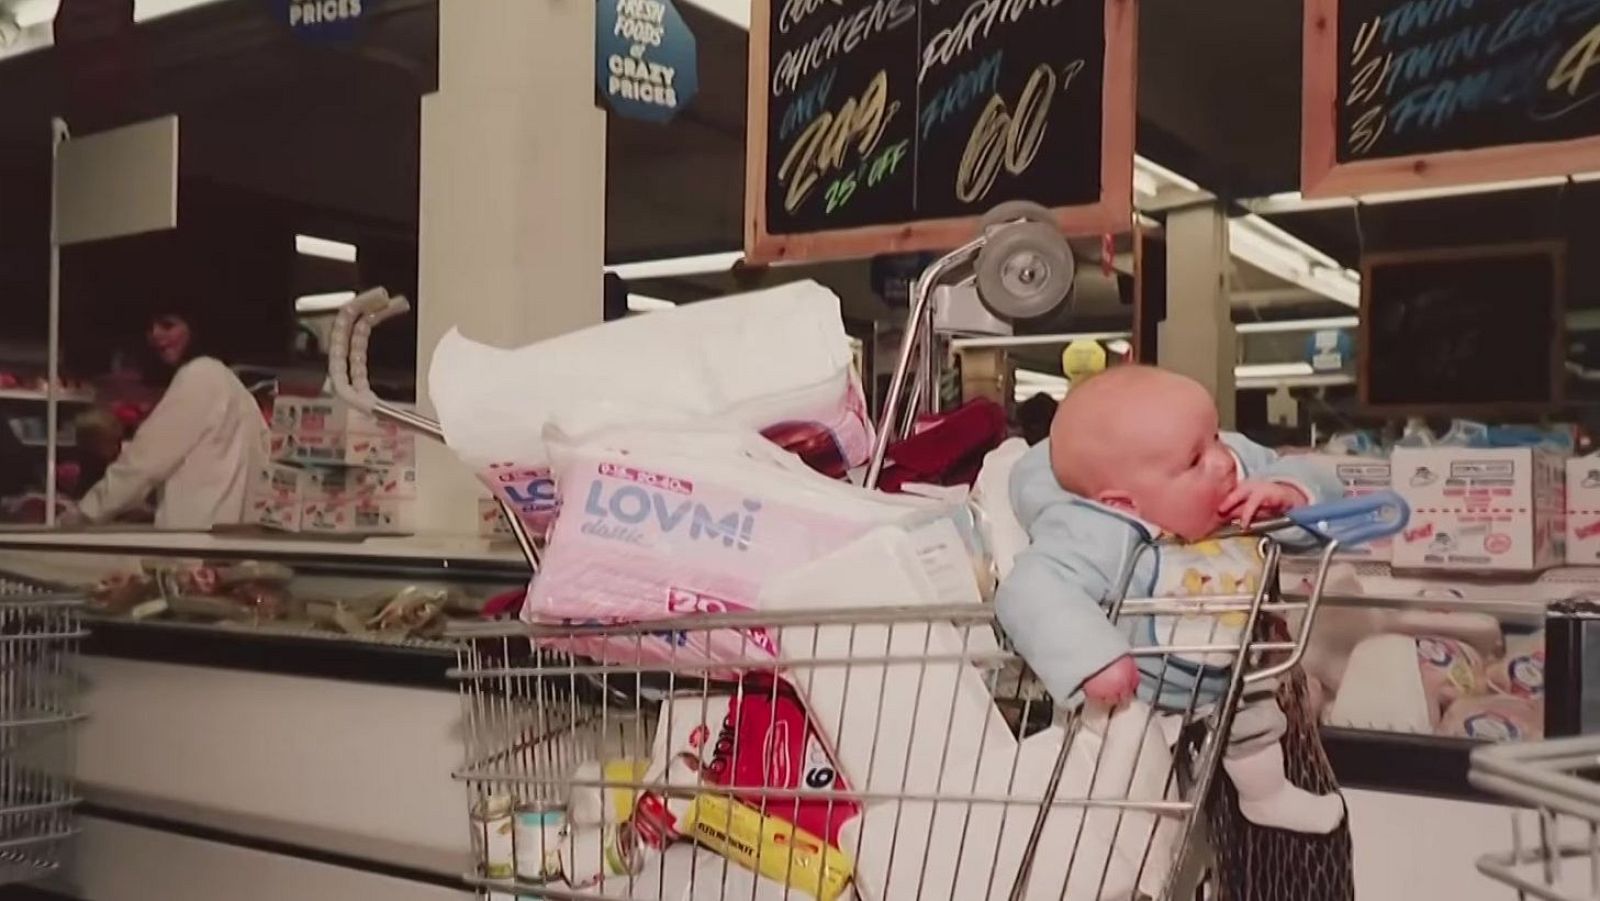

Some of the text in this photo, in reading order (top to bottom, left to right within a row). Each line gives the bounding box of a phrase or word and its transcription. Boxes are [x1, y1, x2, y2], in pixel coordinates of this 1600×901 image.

[289, 0, 361, 27] PRICES
[616, 0, 665, 25] FRESH
[773, 0, 915, 96] CHICKENS
[1346, 53, 1392, 106] 2)
[1386, 23, 1488, 96] TWIN
[609, 54, 675, 87] CRAZY
[609, 75, 677, 107] PRICES
[921, 50, 1002, 140] FROM
